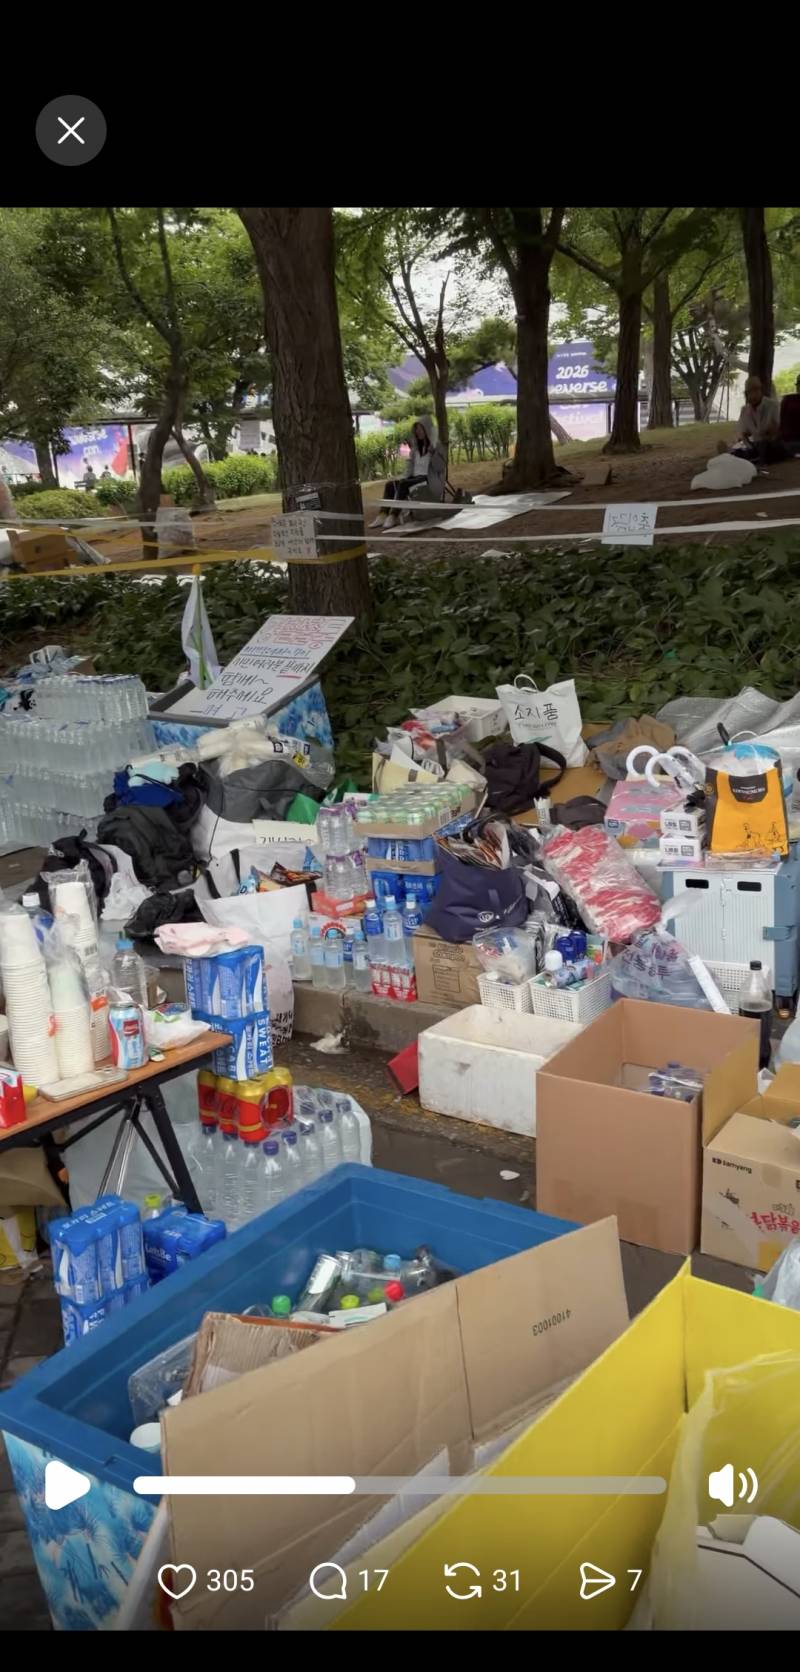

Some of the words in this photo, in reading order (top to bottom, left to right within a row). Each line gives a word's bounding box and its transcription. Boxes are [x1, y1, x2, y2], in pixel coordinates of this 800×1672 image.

[556, 365, 589, 379] 2026
[551, 381, 608, 394] everse
[206, 687, 273, 705] 해주세요
[258, 1019, 268, 1065] SWEAT
[723, 1160, 752, 1174] samyang
[532, 1308, 571, 1337] 41001003
